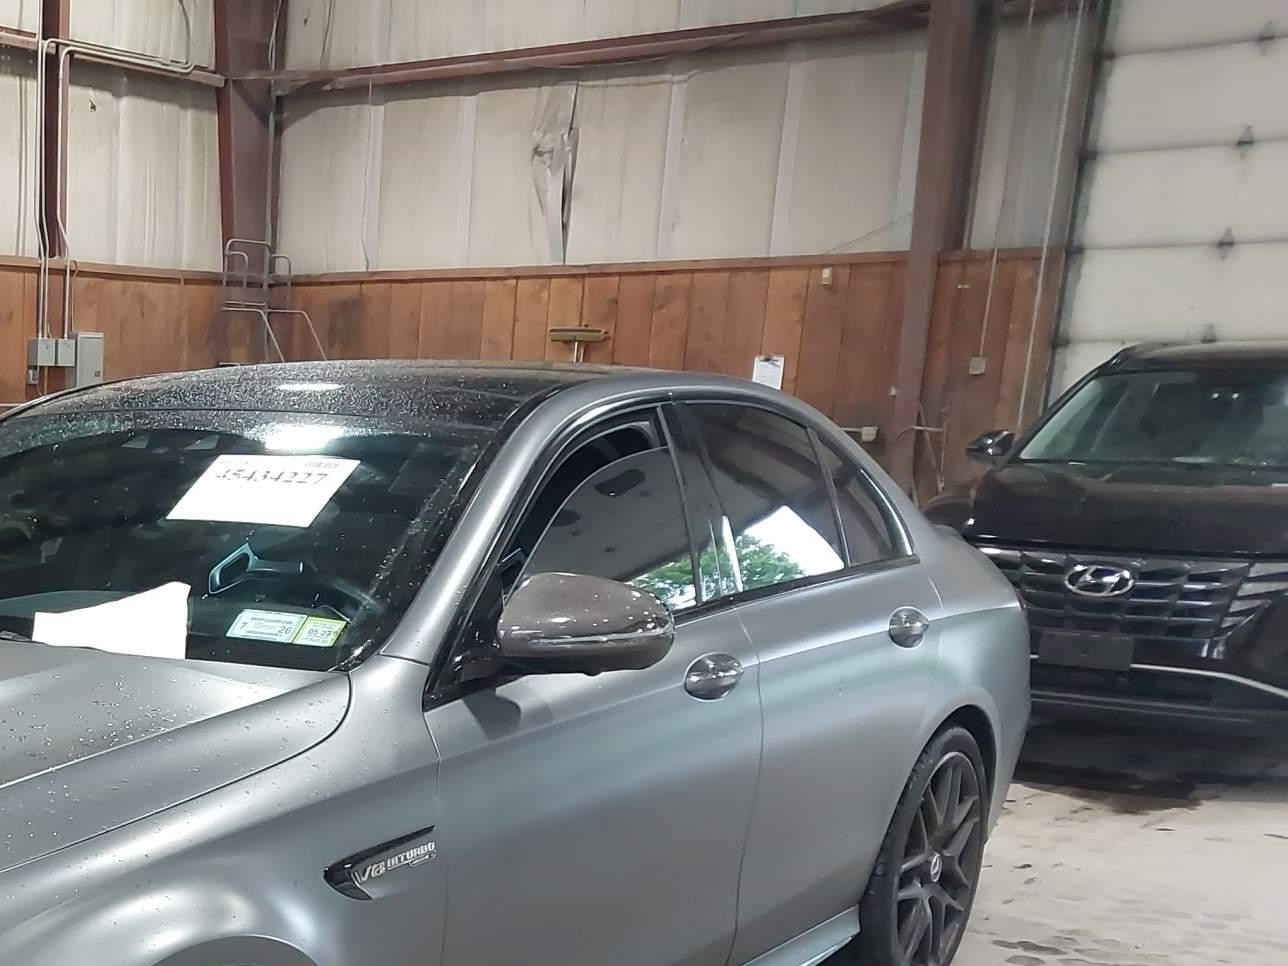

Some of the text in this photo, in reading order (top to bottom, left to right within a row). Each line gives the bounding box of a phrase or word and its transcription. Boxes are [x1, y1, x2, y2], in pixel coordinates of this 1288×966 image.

[215, 469, 329, 485] 45434227
[278, 626, 292, 635] 26
[387, 842, 435, 868] BITURBO
